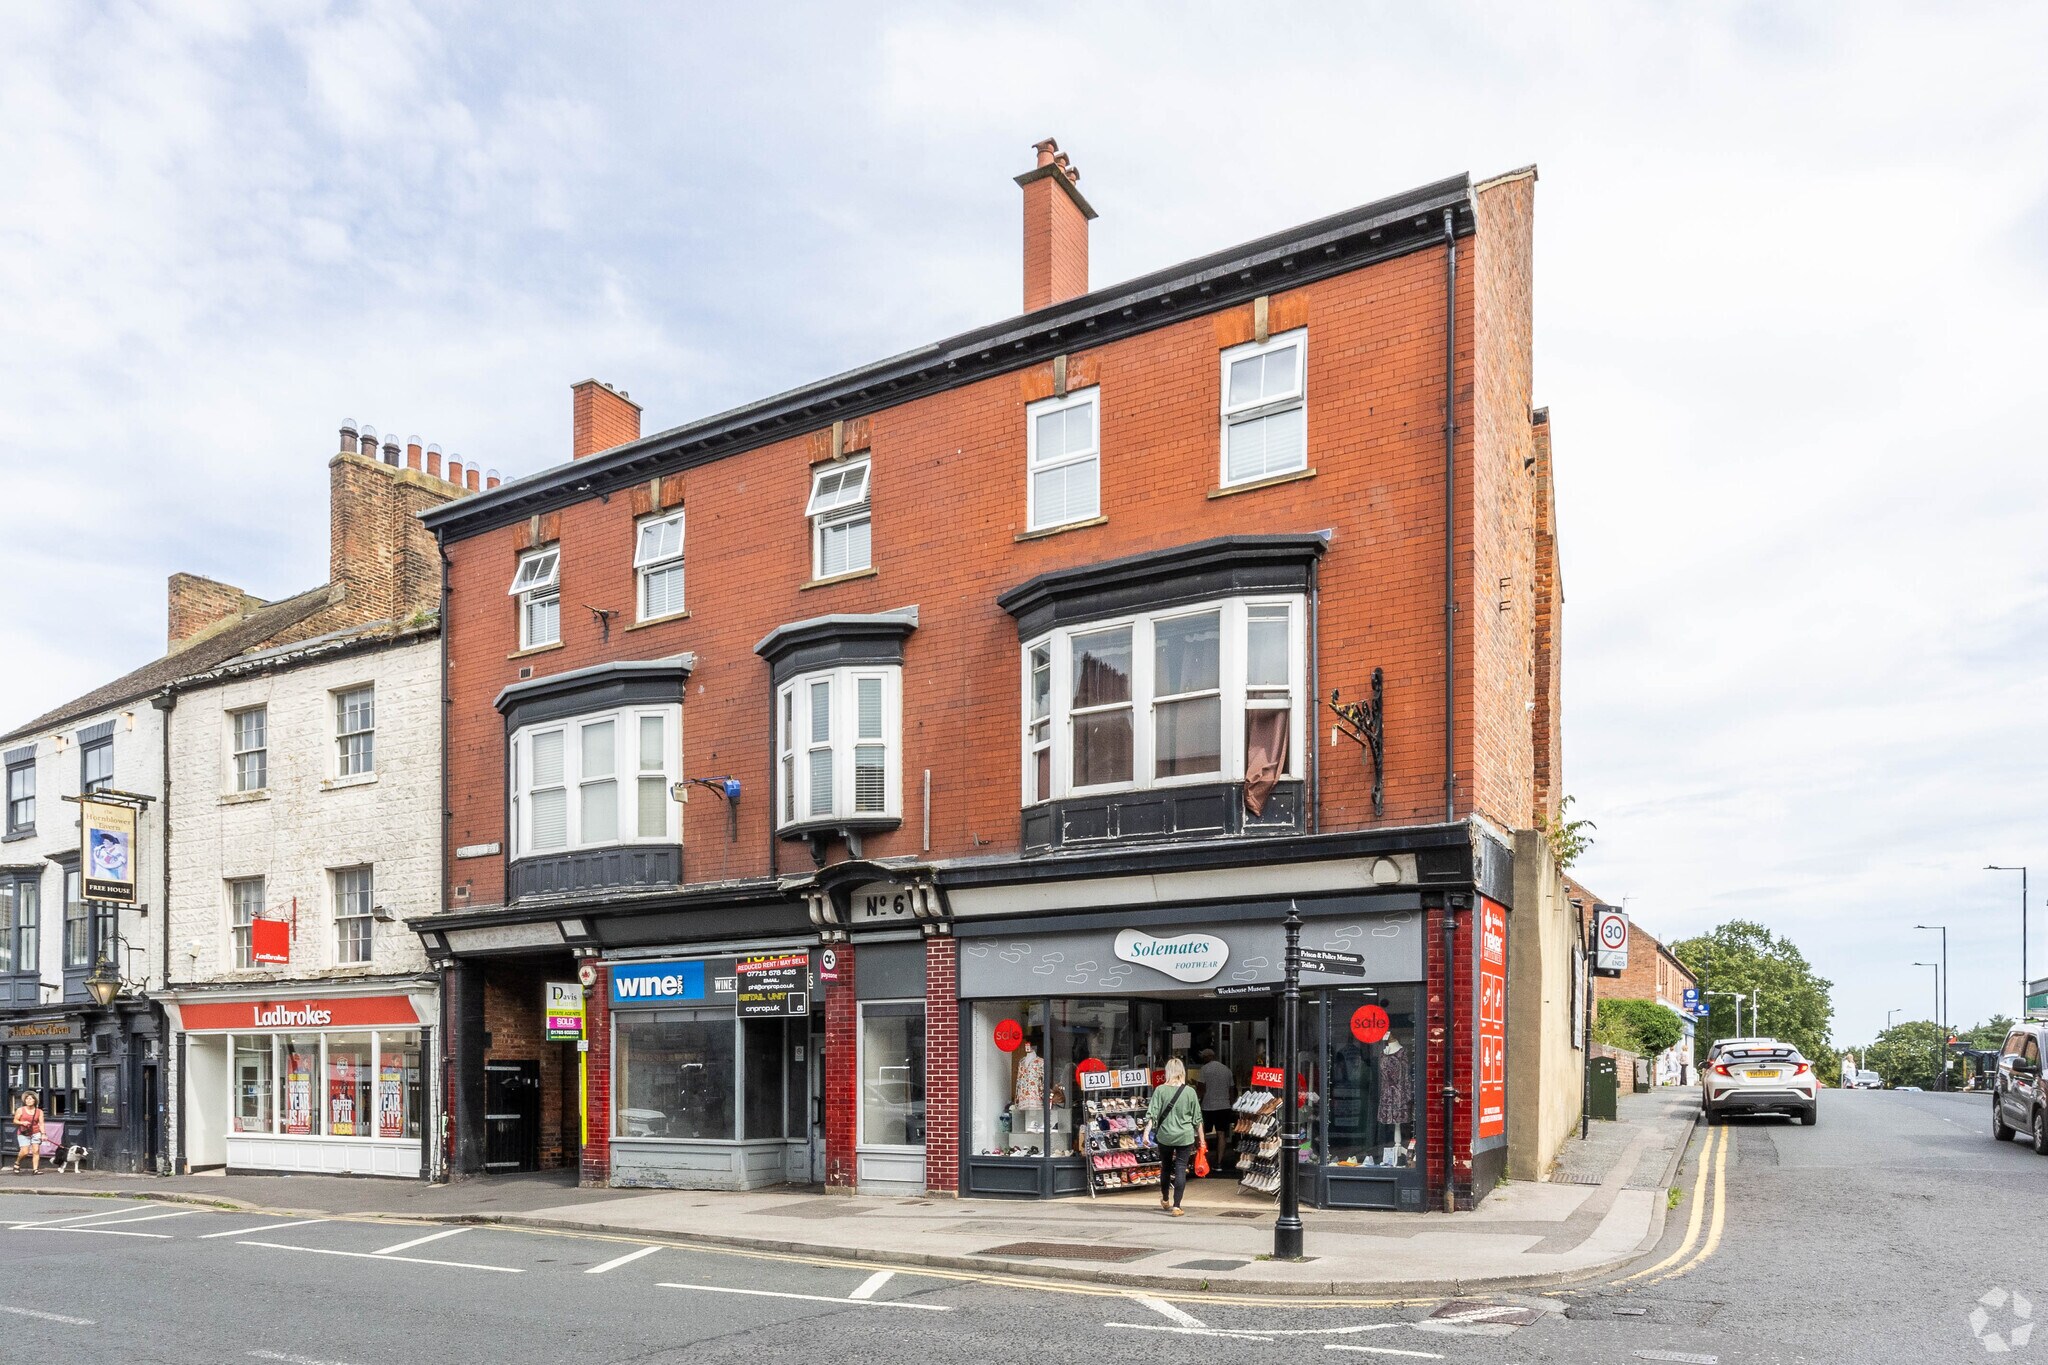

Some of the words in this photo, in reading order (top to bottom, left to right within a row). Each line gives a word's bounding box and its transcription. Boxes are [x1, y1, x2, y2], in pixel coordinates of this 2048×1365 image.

[86, 813, 131, 825] Hornblower
[99, 823, 121, 831] Tavern
[89, 884, 106, 892] FREE
[893, 895, 904, 914] 6
[1605, 925, 1622, 939] 30
[1131, 941, 1210, 957] Solemates
[255, 953, 288, 961] Ladbrokes
[1301, 950, 1316, 958] Prison
[1322, 952, 1336, 960] Police
[1336, 954, 1358, 962] Museum
[737, 963, 762, 971] REDUCED
[1175, 961, 1218, 969] FOOTWEAR
[1301, 961, 1317, 969] Toilets
[616, 975, 678, 997] wine
[715, 979, 732, 990] WINE
[552, 987, 577, 1000] Davis
[738, 993, 766, 1001] RETAIL
[767, 992, 787, 1000] UNIT
[556, 994, 577, 1006] Lund
[253, 1005, 332, 1026] Ladbrokes
[1354, 1012, 1386, 1029] sale
[996, 1026, 1020, 1040] sale
[1089, 1074, 1106, 1085] £10
[1125, 1072, 1142, 1082] £10
[289, 1093, 309, 1110] YEAR
[341, 1110, 352, 1123] ALL
